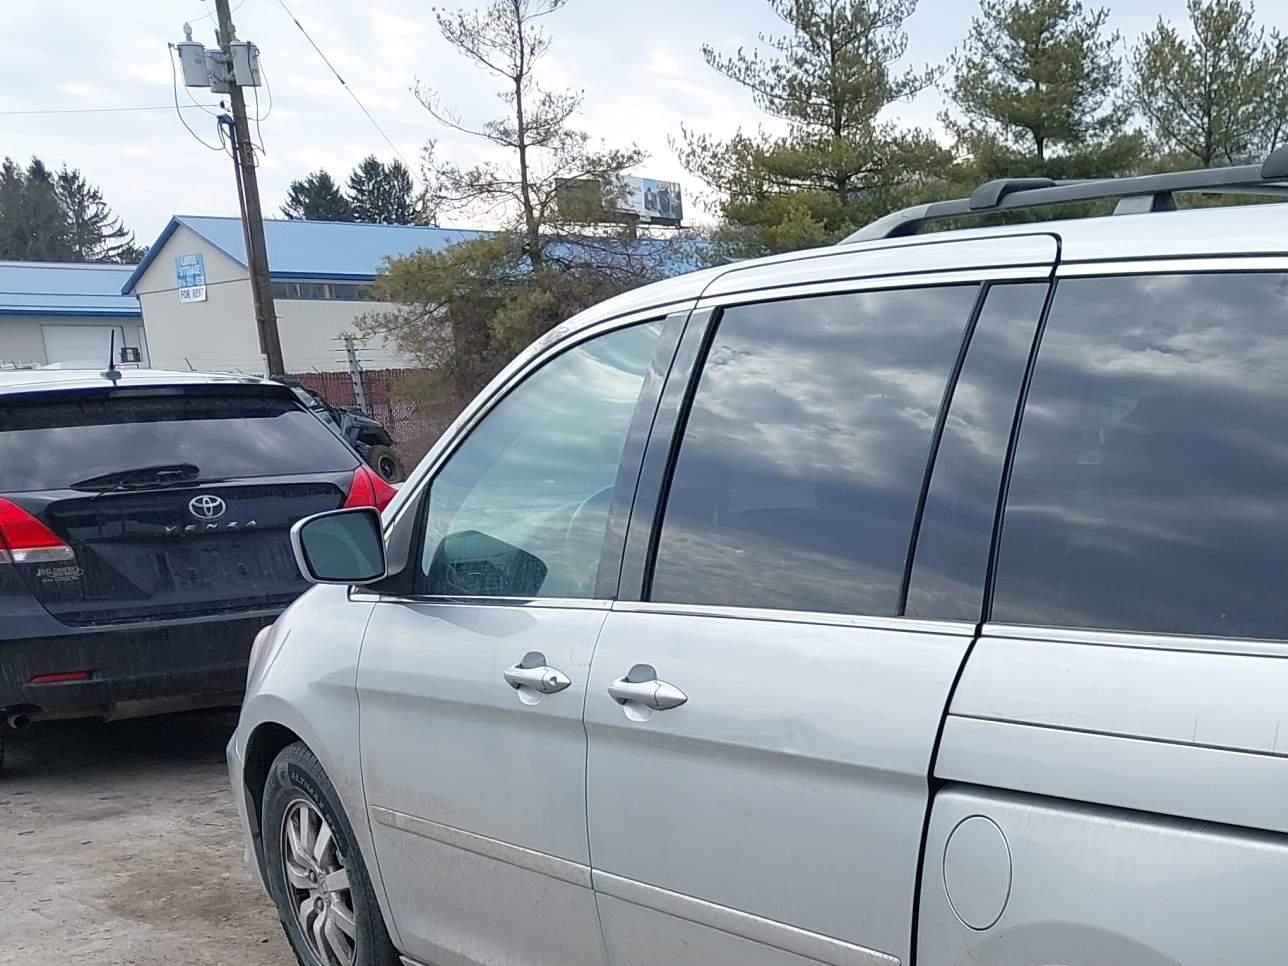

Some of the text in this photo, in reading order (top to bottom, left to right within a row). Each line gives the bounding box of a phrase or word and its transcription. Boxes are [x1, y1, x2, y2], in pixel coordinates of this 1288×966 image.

[180, 286, 205, 299] FOR RENT
[163, 519, 257, 533] VENZA
